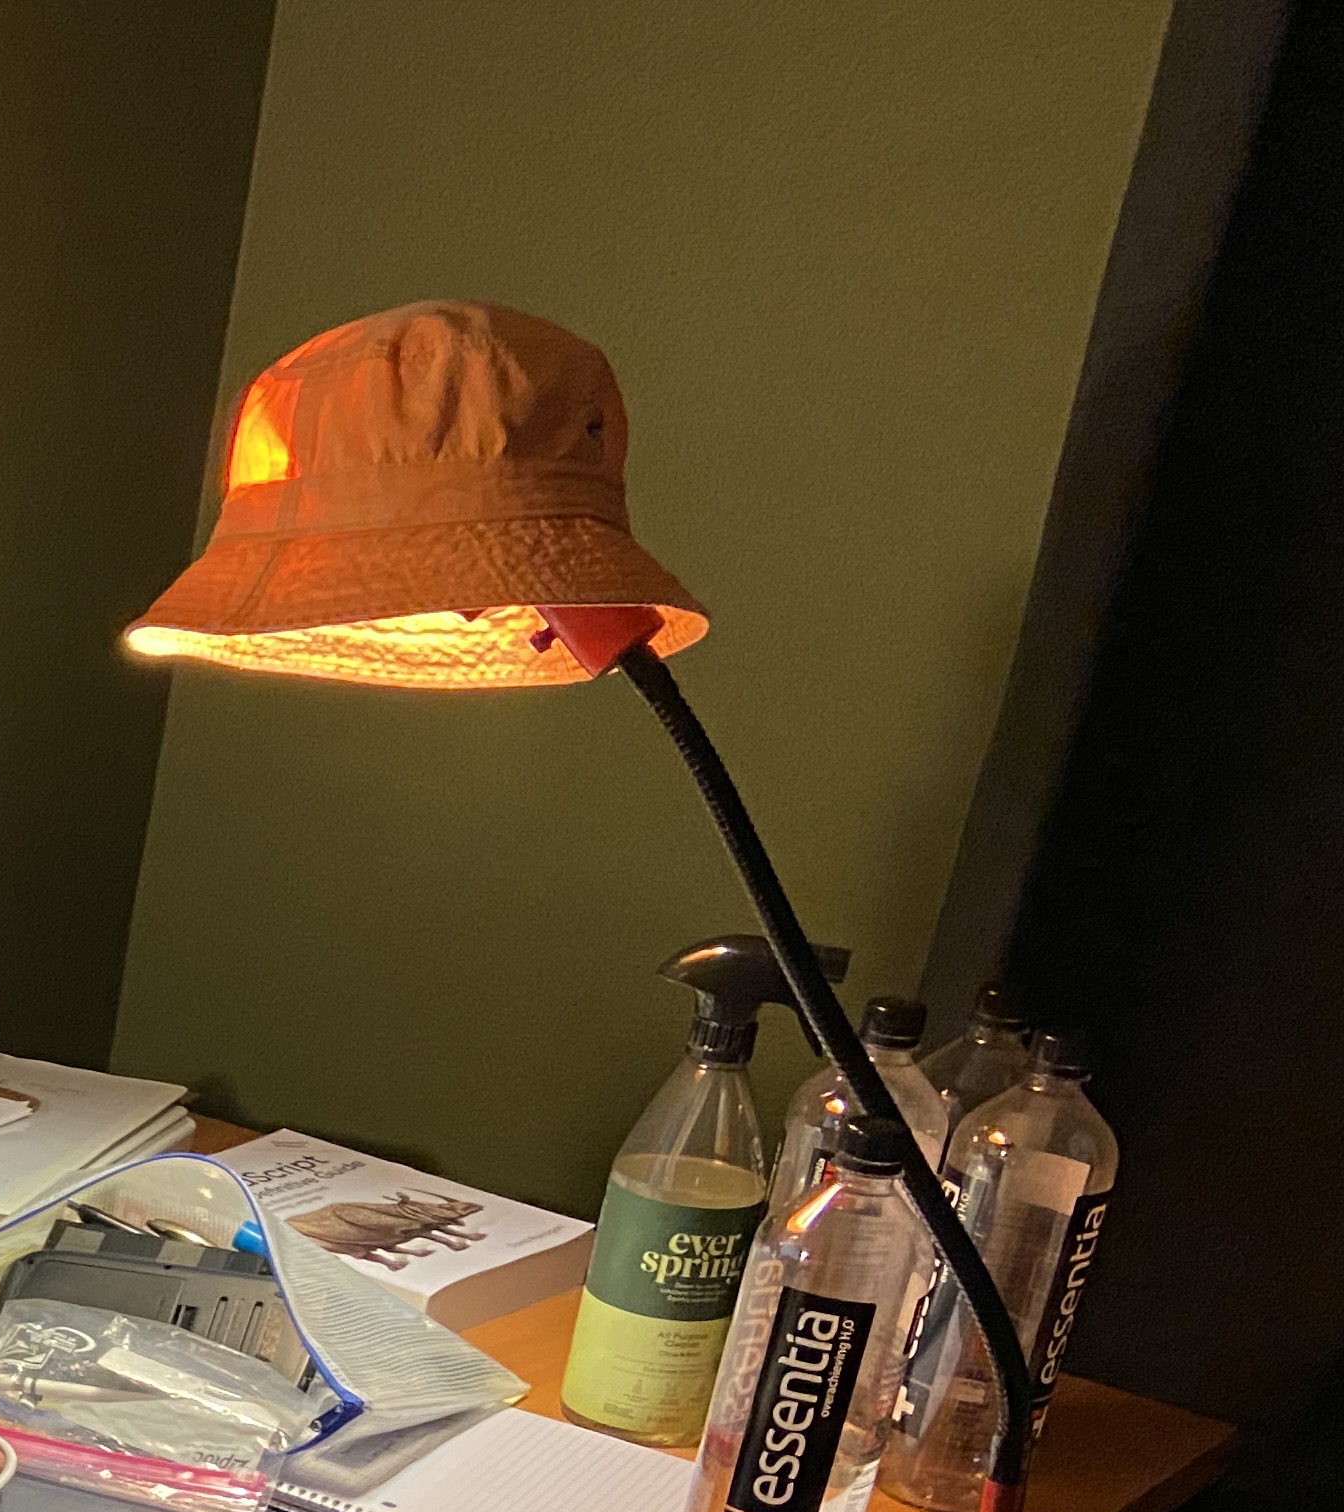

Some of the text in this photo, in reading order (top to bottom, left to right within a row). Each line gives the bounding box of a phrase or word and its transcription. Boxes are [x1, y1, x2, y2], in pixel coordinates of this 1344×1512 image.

[243, 1154, 330, 1187] Script
[669, 1232, 742, 1256] ever
[1040, 1203, 1107, 1385] essentia
[753, 1310, 840, 1505] essentia
[821, 1341, 852, 1418] overachieving
